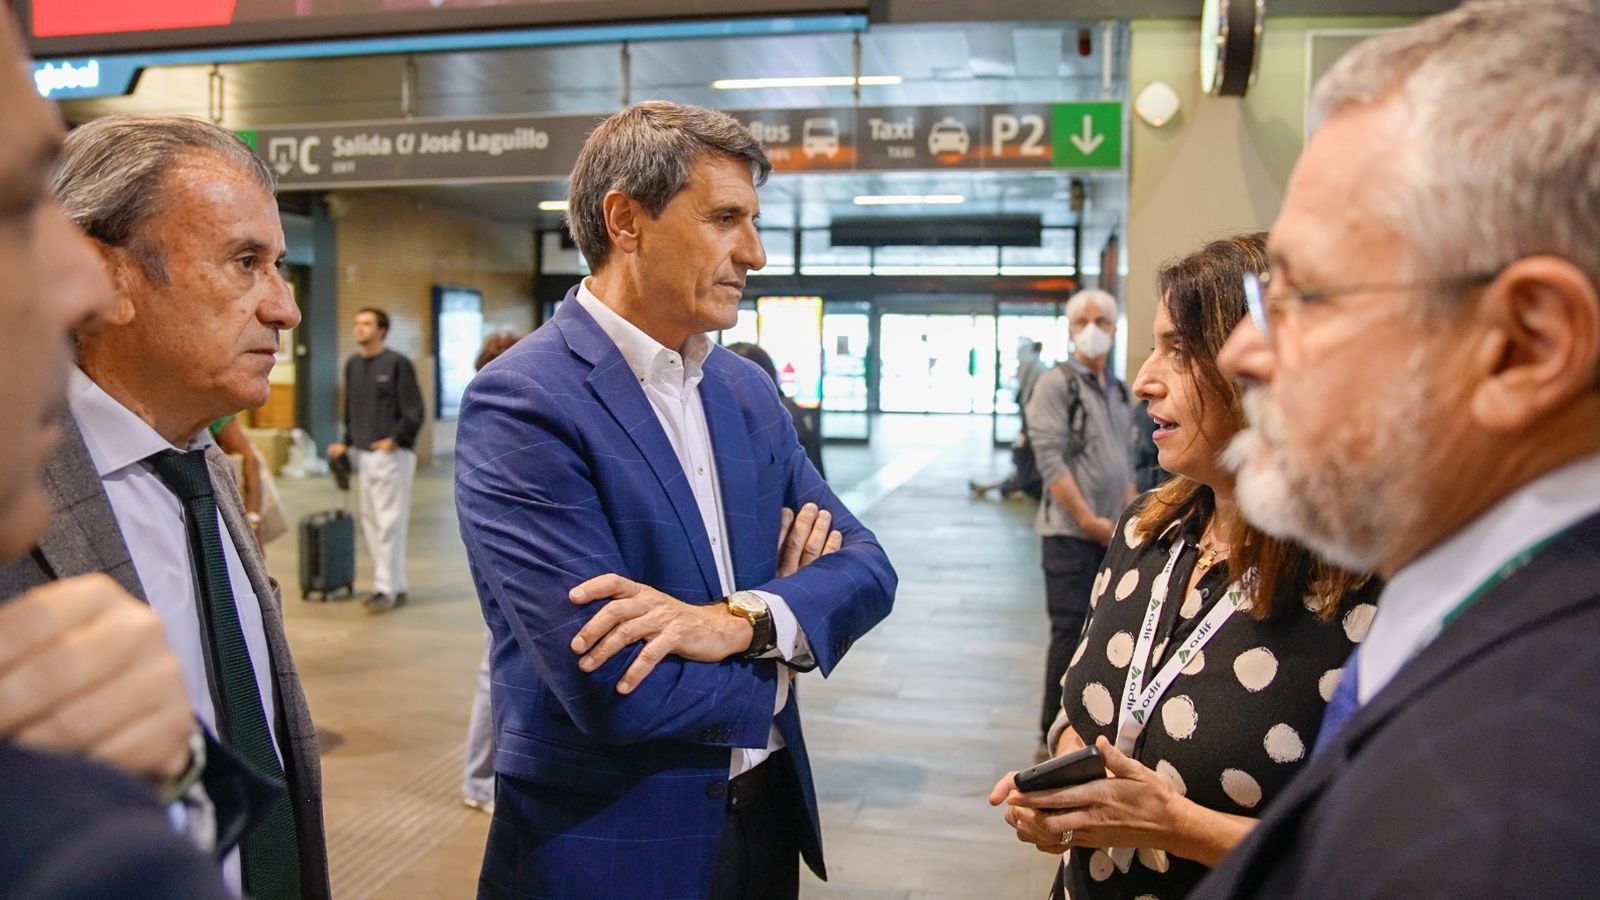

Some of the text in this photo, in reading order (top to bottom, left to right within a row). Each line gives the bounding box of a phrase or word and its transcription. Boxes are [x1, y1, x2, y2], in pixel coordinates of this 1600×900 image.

[749, 121, 791, 142] Bus
[869, 118, 915, 141] Taxi
[992, 114, 1046, 157] P2
[300, 127, 549, 175] C Salida C/ José Laguillo
[1189, 620, 1212, 649] adif
[1142, 679, 1162, 708] adif
